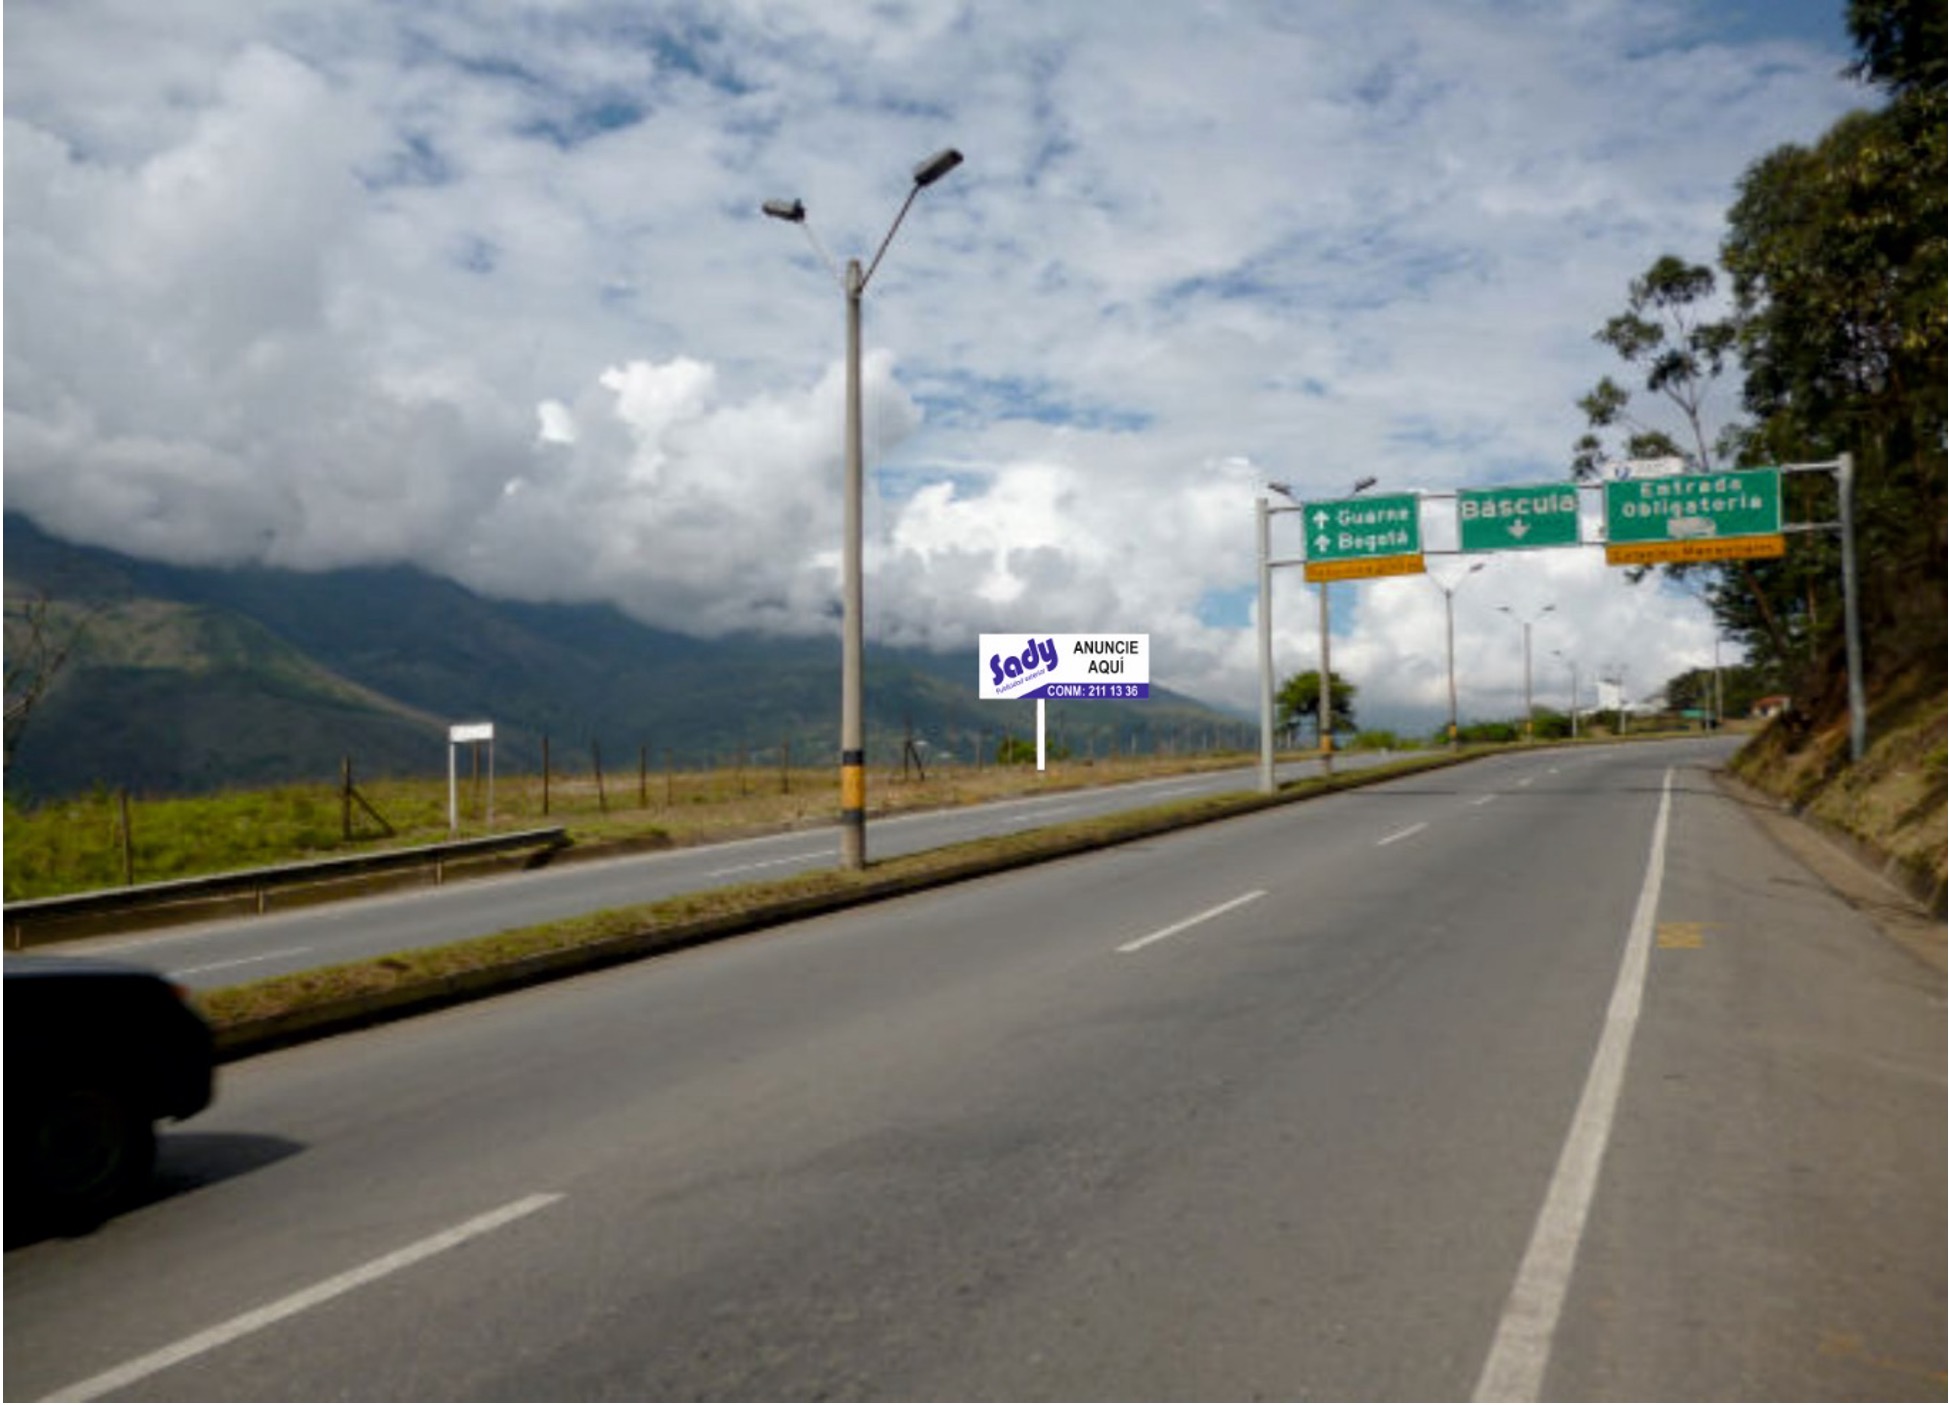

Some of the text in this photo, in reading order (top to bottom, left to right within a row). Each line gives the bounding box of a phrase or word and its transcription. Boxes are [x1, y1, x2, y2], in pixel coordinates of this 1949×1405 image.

[1622, 492, 1764, 518] Obligatoria
[1073, 640, 1139, 655] ANUNCIE
[989, 637, 1059, 686] Sady
[1088, 656, 1124, 674] AQUÍ
[1047, 684, 1139, 697] CONM: 211 13 36
